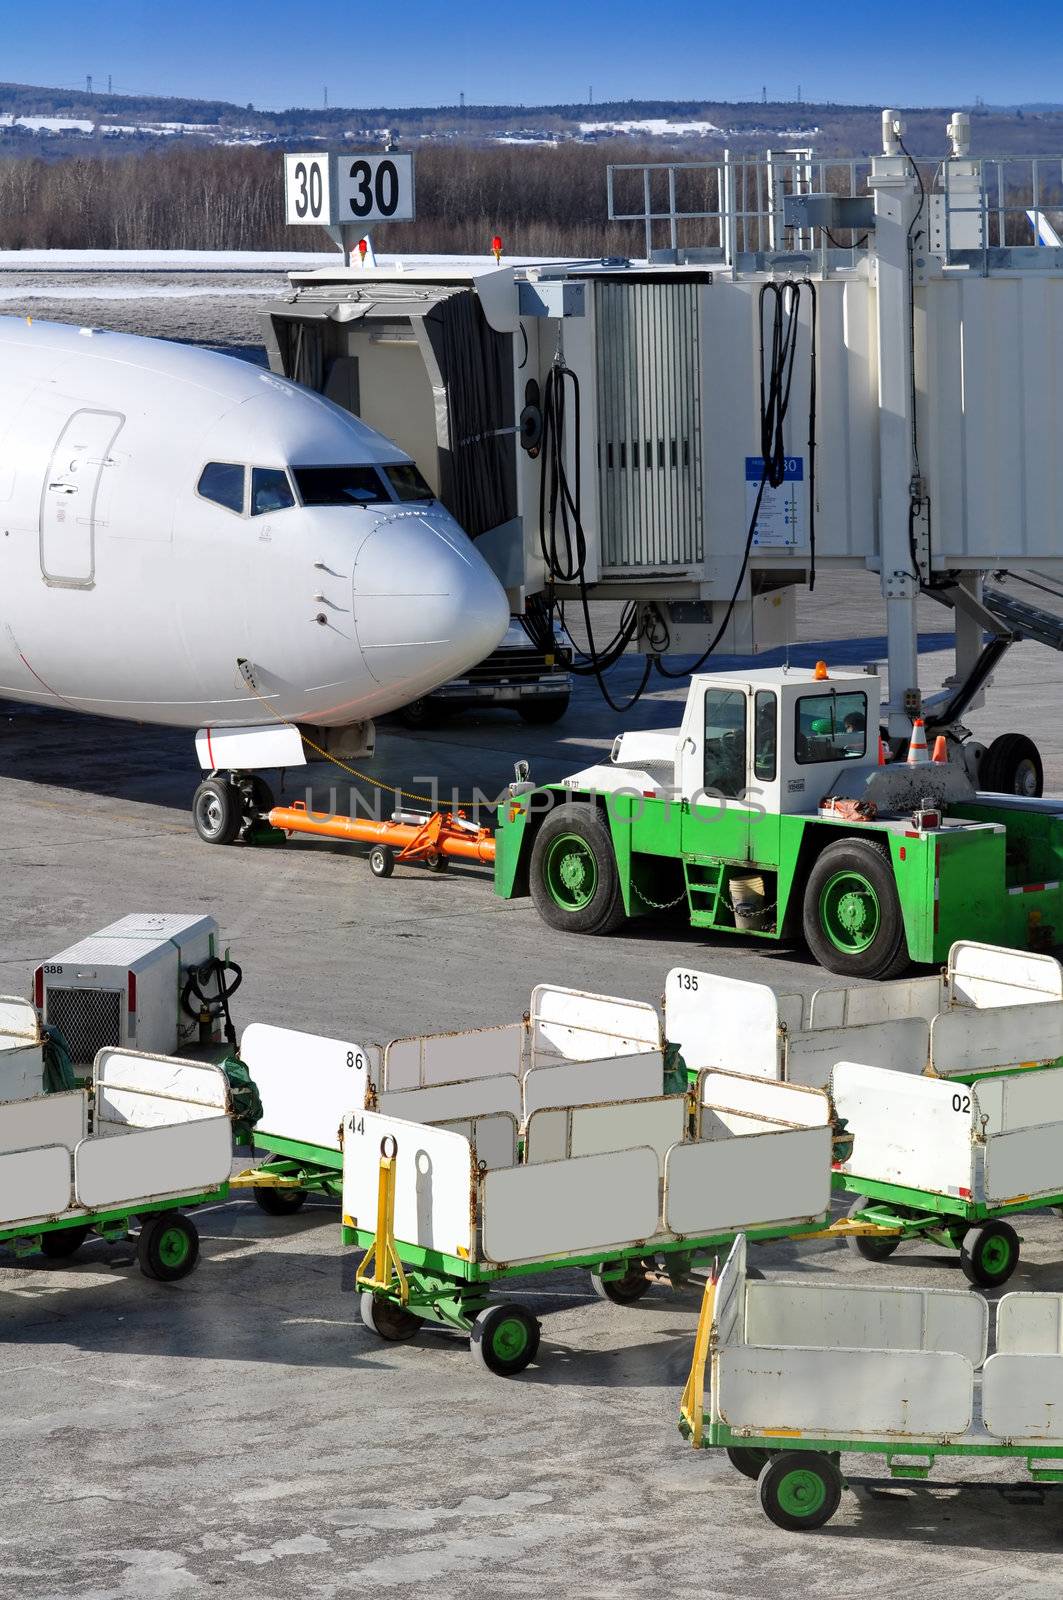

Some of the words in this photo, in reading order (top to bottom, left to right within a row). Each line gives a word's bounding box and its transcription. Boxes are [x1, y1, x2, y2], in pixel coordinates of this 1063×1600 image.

[295, 162, 322, 218] 30
[349, 160, 399, 217] 30
[44, 965, 63, 974] 388
[676, 973, 699, 991] 135
[346, 1051, 363, 1070] 86
[952, 1094, 971, 1114] 02
[348, 1115, 365, 1136] 44
